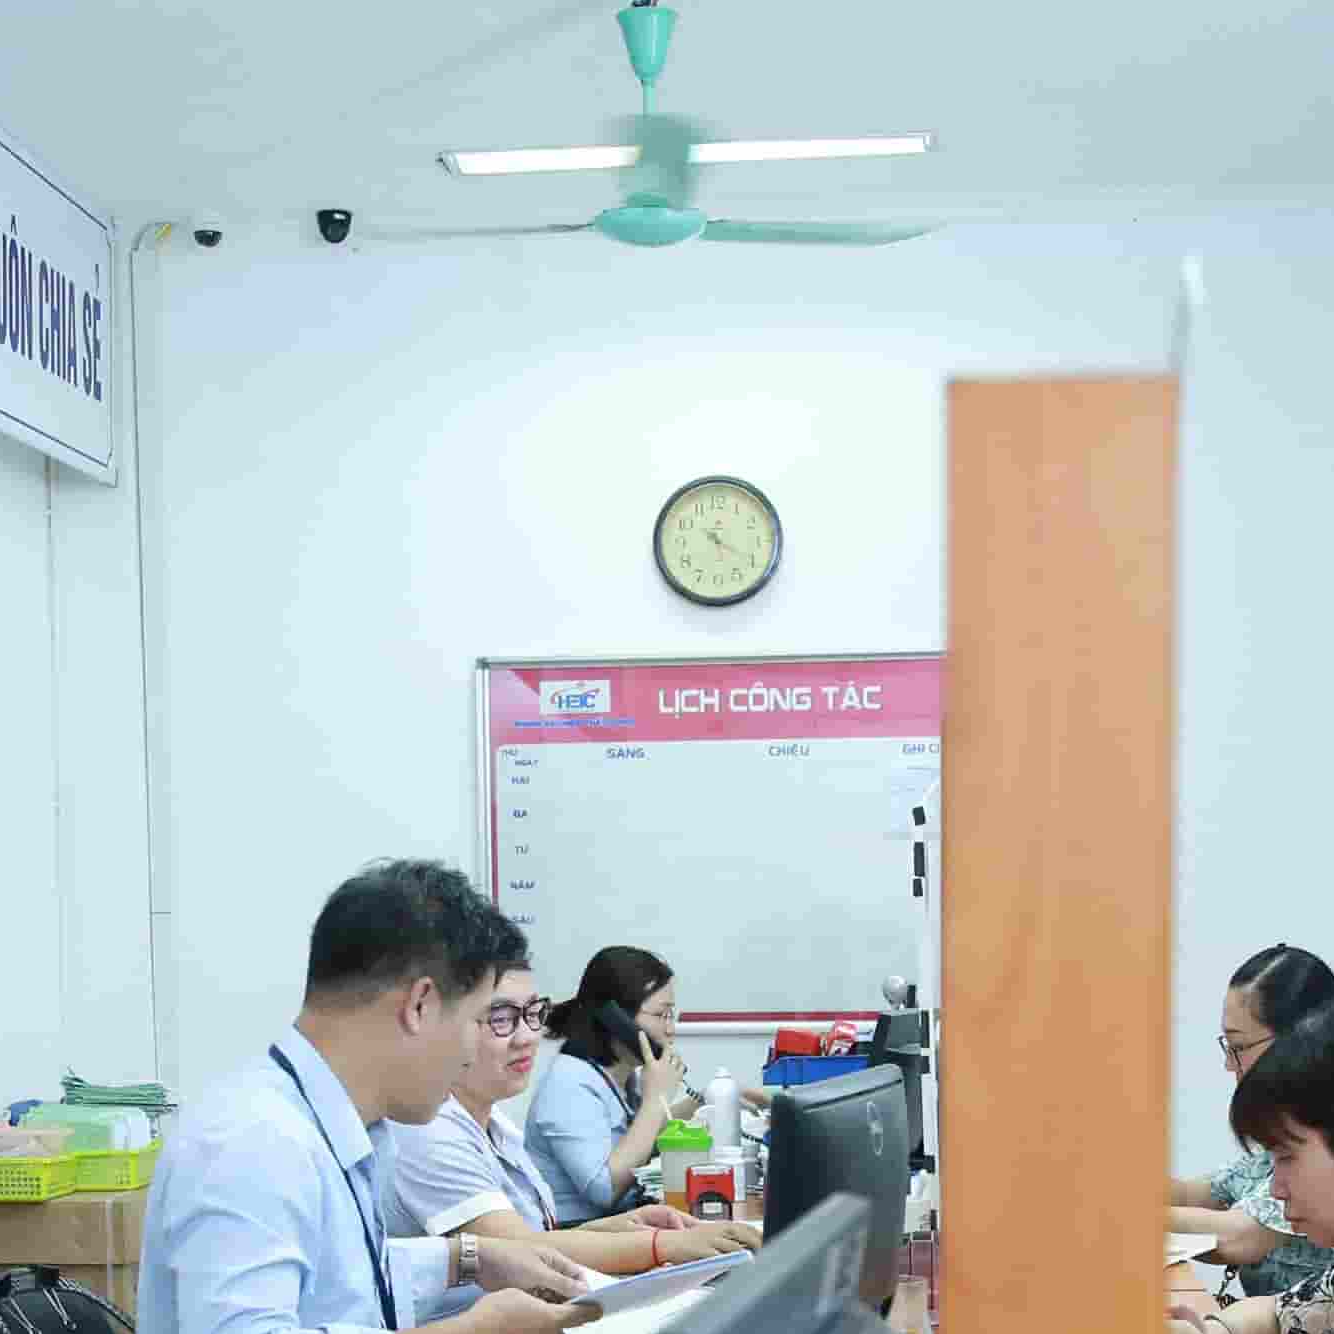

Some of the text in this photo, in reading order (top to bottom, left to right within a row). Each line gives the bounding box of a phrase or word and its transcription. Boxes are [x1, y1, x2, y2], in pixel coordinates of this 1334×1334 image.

[38, 259, 78, 388] CHIA
[658, 679, 883, 720] LỊCH CÔNG TÁC
